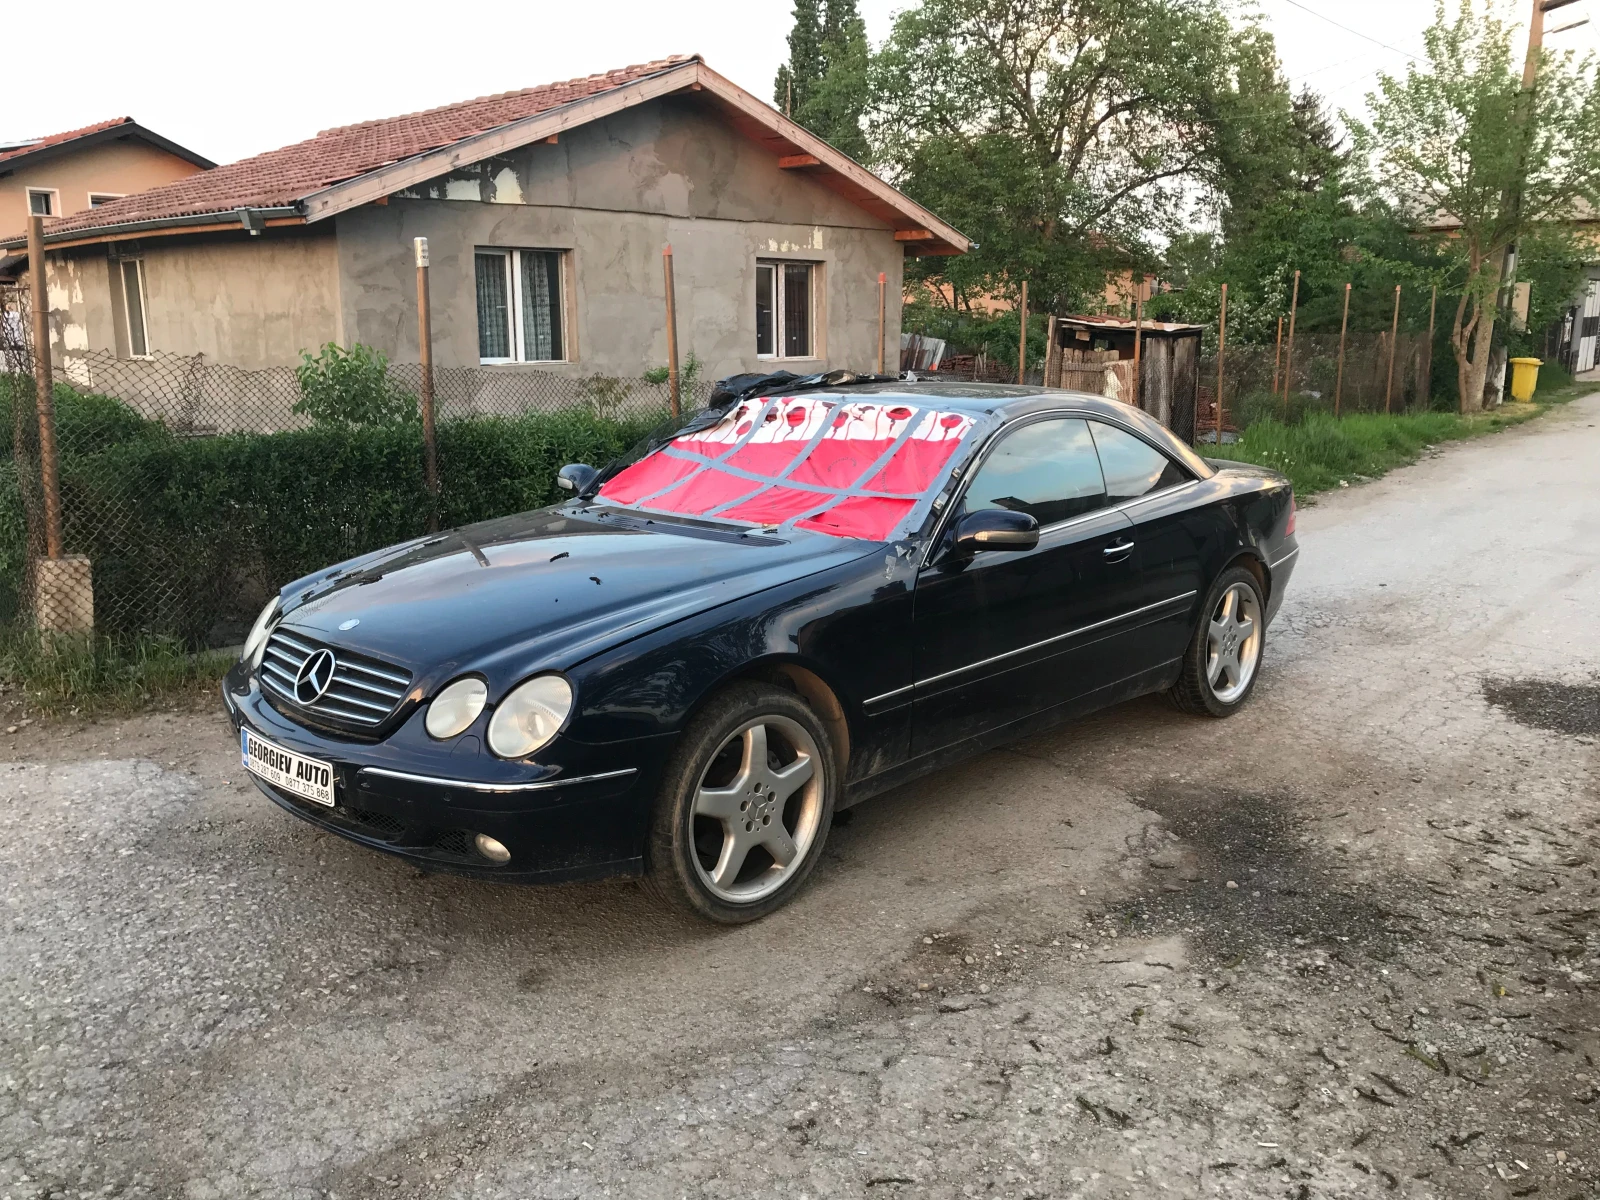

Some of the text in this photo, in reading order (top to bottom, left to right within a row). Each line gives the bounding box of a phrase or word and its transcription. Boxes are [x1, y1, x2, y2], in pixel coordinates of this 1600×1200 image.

[249, 737, 329, 787] GEORGIEV AUTO
[271, 768, 280, 781] 609
[285, 776, 300, 790] 0877
[302, 783, 314, 795] 375
[317, 788, 329, 800] 868
